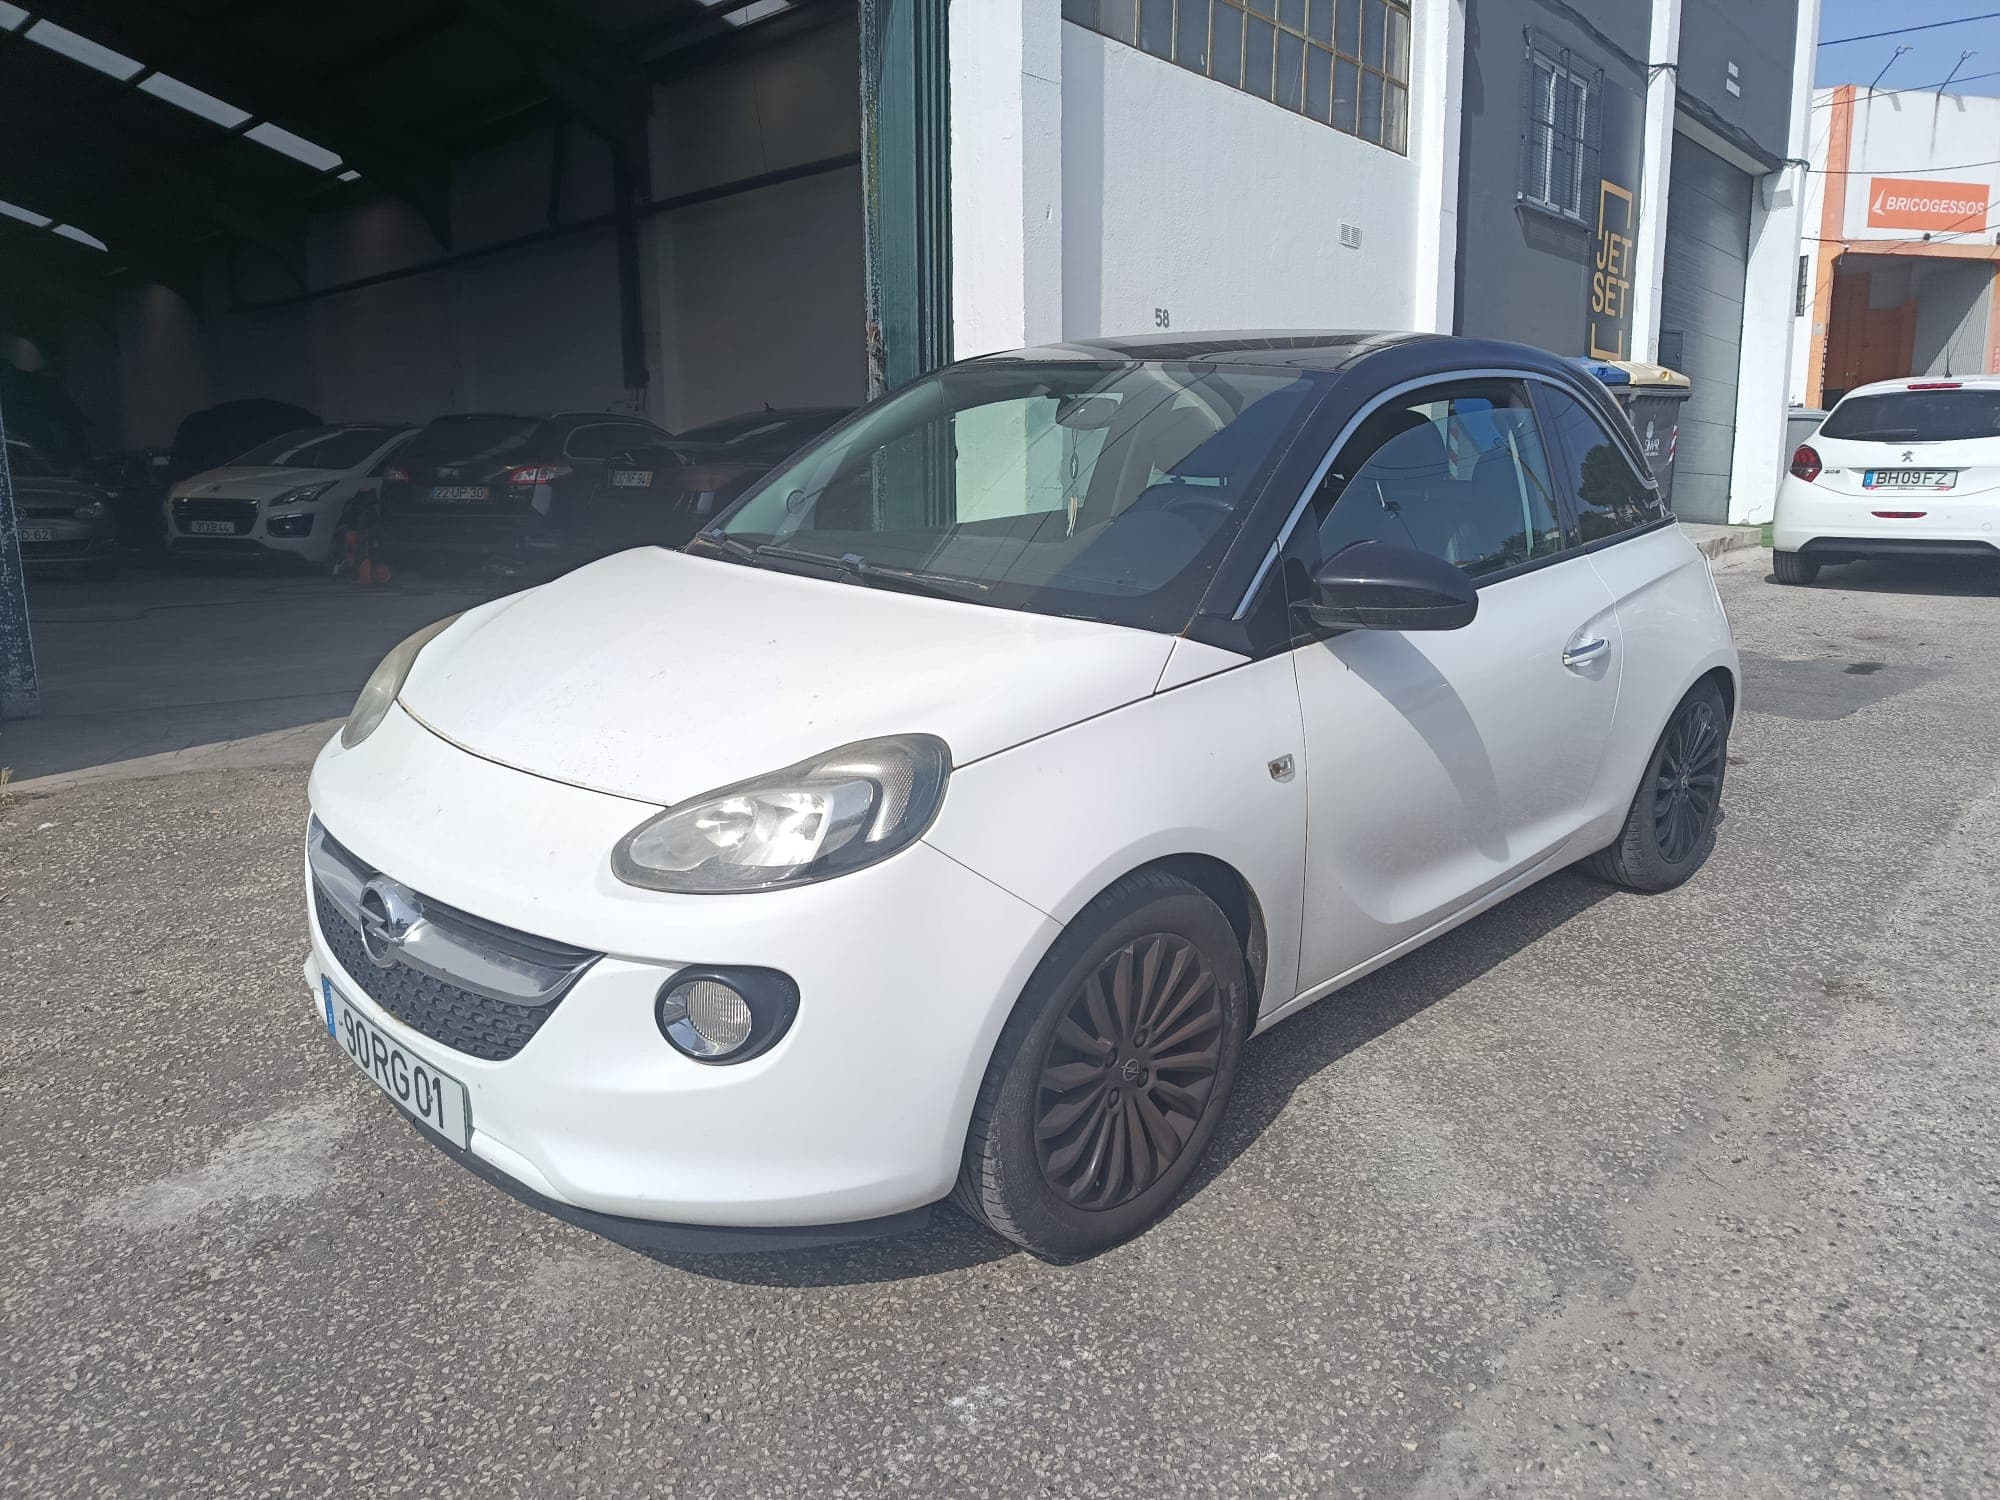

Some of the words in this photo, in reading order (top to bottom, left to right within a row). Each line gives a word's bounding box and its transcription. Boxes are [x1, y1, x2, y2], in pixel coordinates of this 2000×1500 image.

[1886, 197, 1985, 216] BRICOGESSOS
[1596, 230, 1632, 278] JET
[1592, 272, 1629, 319] SET
[1155, 308, 1170, 329] 58
[1876, 472, 1948, 485] BH09FZ
[343, 1008, 444, 1129] 90RG01
